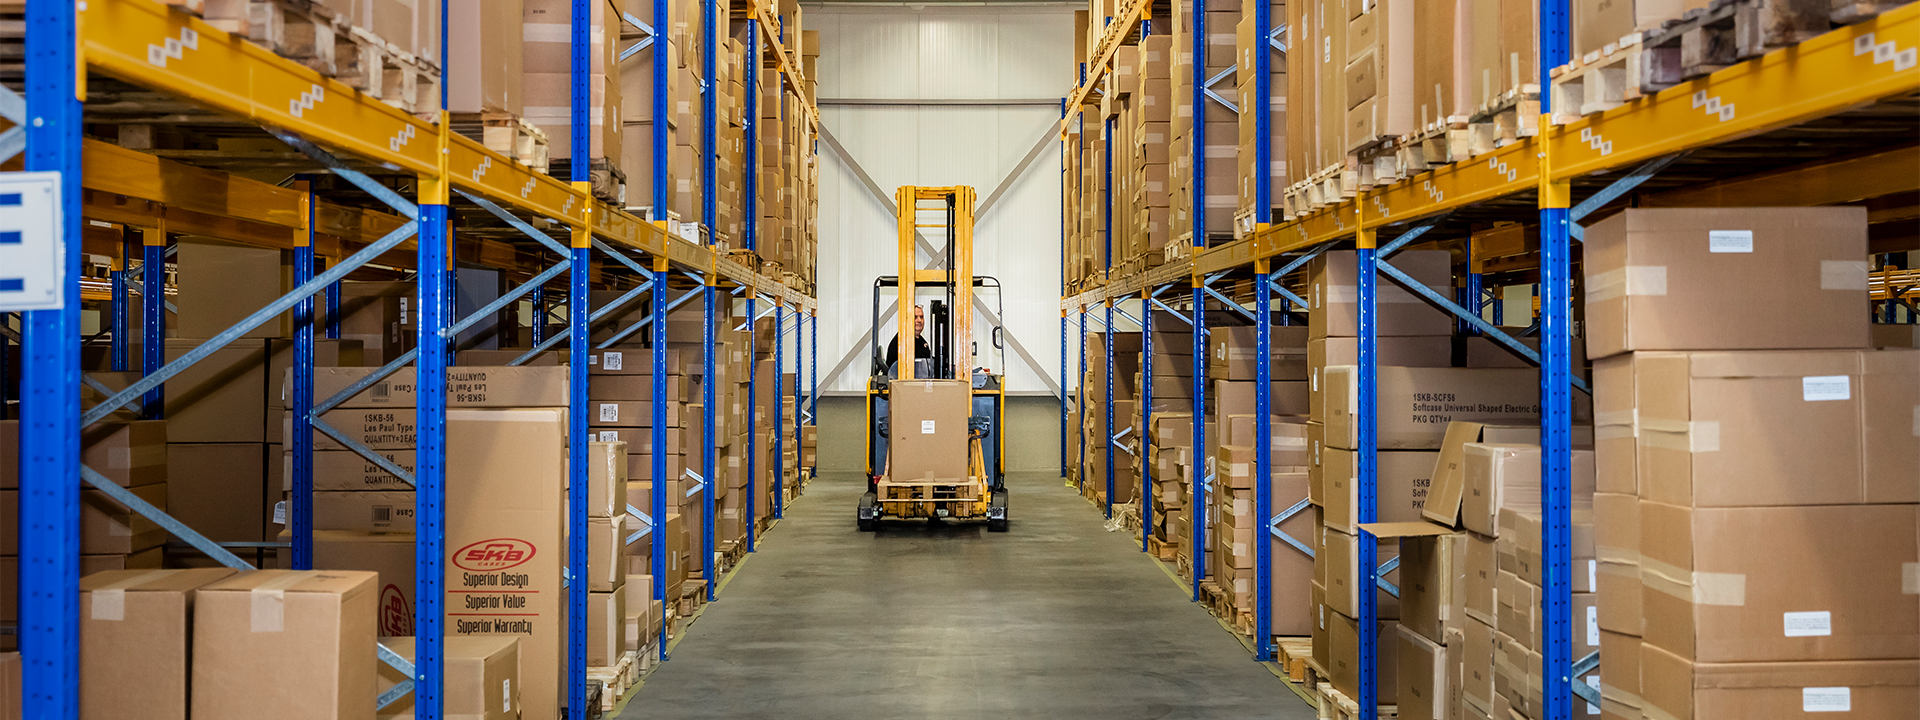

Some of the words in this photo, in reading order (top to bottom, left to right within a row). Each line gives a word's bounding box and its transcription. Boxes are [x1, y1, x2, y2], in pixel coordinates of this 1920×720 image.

[447, 373, 487, 381] QUANTITY=2
[394, 385, 411, 393] Case
[446, 382, 454, 392] Ty
[456, 384, 471, 392] Paul
[474, 384, 487, 392] Les
[457, 394, 486, 402] 1SKB-56
[1413, 393, 1455, 402] 1SKB-SCFS6
[1412, 403, 1442, 412] Softcase
[1444, 403, 1476, 412] Universal
[1478, 404, 1502, 414] Shaped
[1504, 405, 1530, 413] Electric
[364, 414, 394, 422] 1SKB-56
[1412, 415, 1427, 423] PKG
[364, 424, 376, 432] Les
[379, 424, 395, 432] Paul
[397, 424, 413, 433] Type
[364, 435, 416, 443] QUANTITY=2EAC
[364, 465, 376, 473] Les
[1412, 489, 1428, 497] Soft
[396, 509, 414, 518] Case
[465, 549, 524, 561] SKB
[463, 572, 499, 588] Superior
[501, 572, 528, 589] Design
[465, 594, 500, 611] Superior
[502, 594, 526, 609] Value
[457, 619, 492, 635] Superior
[494, 619, 532, 636] Warranty
